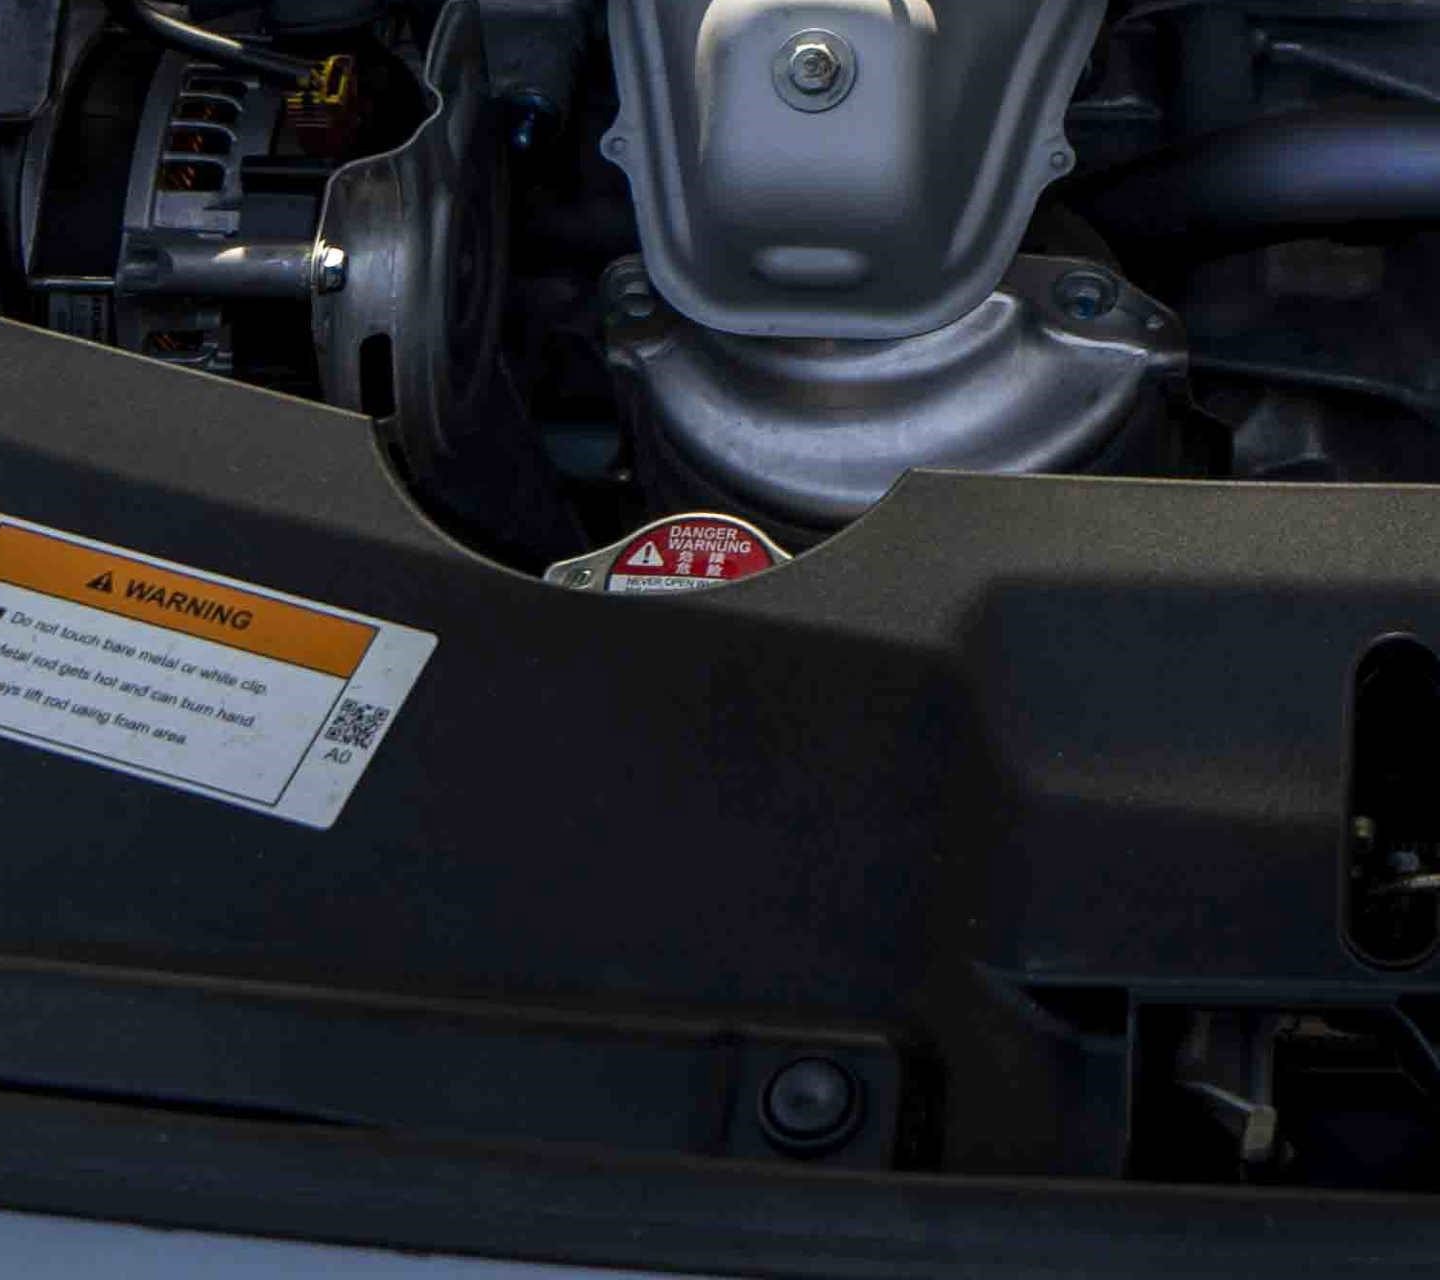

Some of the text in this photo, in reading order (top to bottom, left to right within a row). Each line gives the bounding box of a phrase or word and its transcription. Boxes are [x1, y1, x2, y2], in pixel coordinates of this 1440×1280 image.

[668, 538, 752, 553] WARNUNG
[669, 525, 738, 540] DANGER
[125, 579, 253, 630] WARNING
[10, 611, 33, 627] Do
[34, 621, 59, 636] not
[60, 627, 101, 646] touch
[101, 638, 136, 657] bare
[138, 651, 179, 672] metal
[181, 663, 198, 674] or
[200, 666, 237, 686] white
[33, 657, 58, 670] rod
[58, 663, 90, 681] gets
[93, 672, 119, 688] hot
[119, 680, 150, 697] and
[150, 690, 178, 705] can
[180, 698, 214, 715] burn
[23, 688, 43, 702] lift
[43, 695, 69, 710] rod
[71, 703, 112, 725] using
[113, 713, 150, 733] foam
[322, 747, 352, 764] A0
